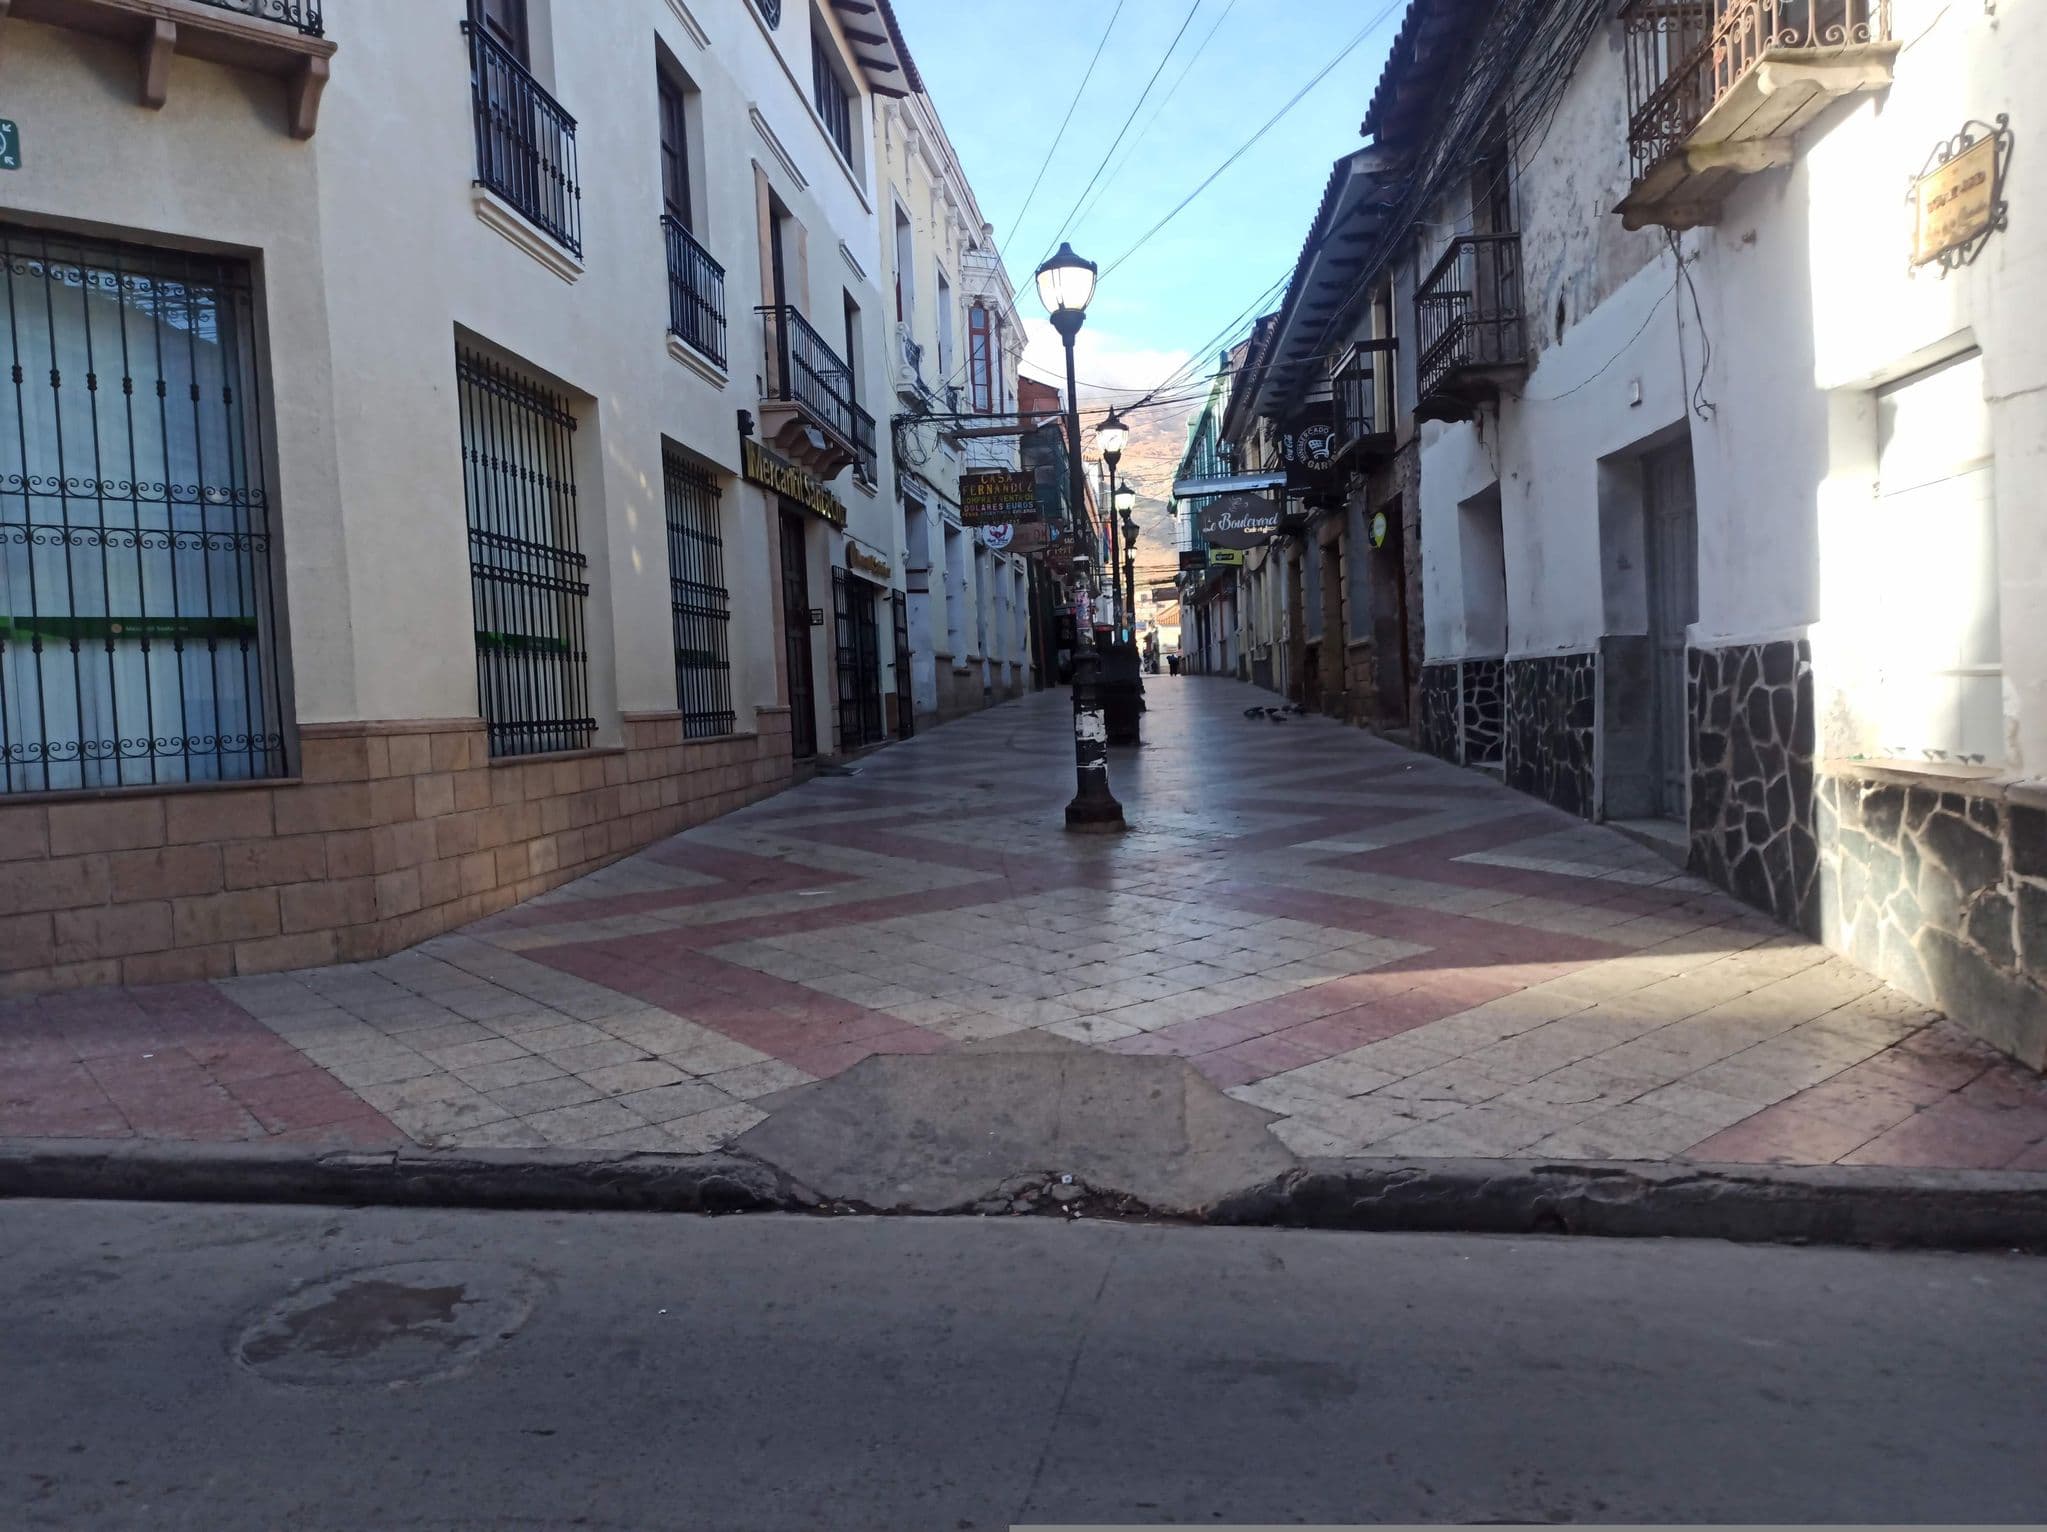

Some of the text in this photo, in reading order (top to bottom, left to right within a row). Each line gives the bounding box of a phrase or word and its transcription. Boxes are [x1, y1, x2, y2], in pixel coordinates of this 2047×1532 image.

[746, 440, 804, 503] Mercantil
[981, 473, 1013, 485] CASA
[963, 503, 1004, 513] DOLARES
[1006, 501, 1034, 510] EUROS
[1218, 512, 1280, 531] Boulevard
